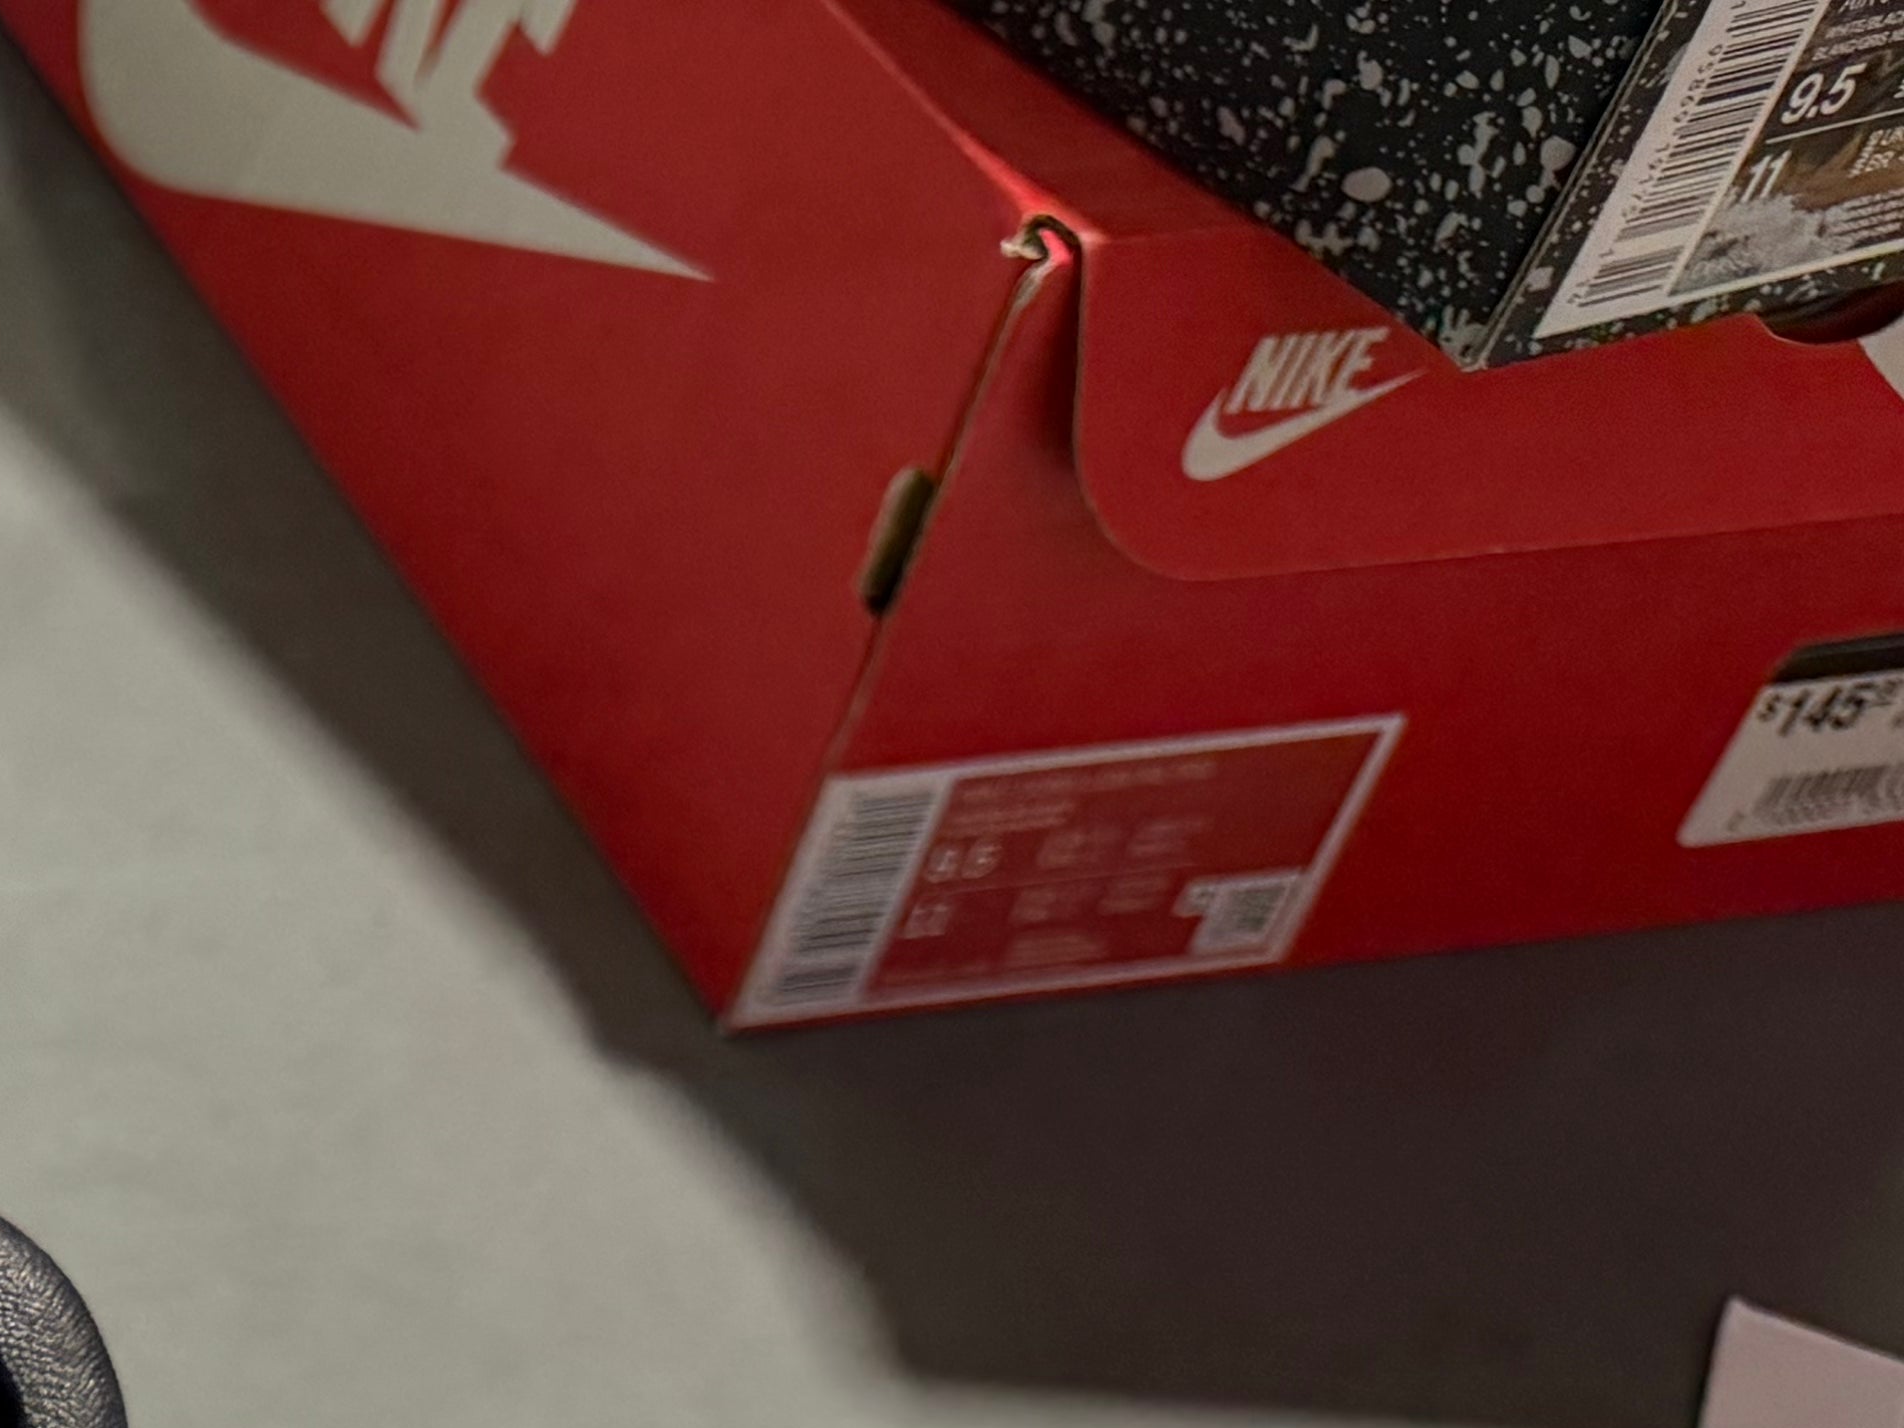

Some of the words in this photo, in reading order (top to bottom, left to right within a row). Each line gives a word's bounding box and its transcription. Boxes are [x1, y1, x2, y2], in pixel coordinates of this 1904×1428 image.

[1781, 62, 1868, 124] 9.5
[1743, 150, 1792, 202] 11
[1221, 327, 1389, 414] NIKE
